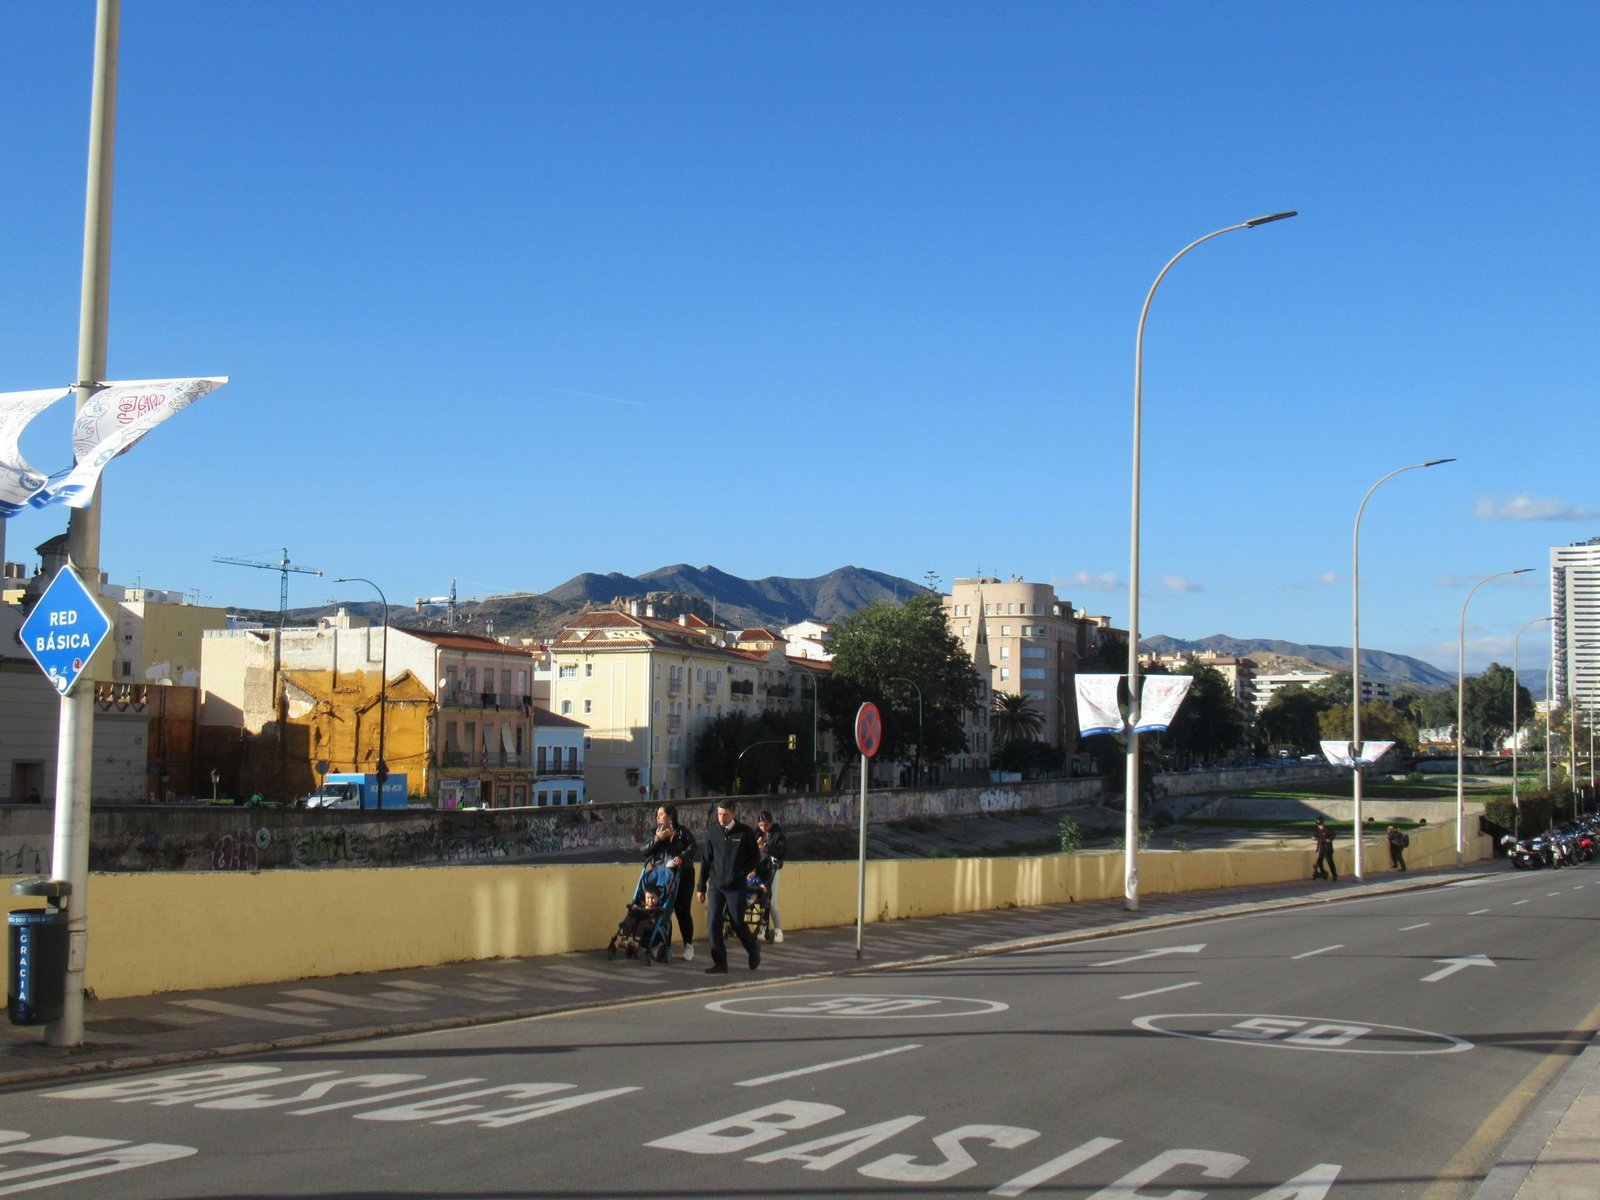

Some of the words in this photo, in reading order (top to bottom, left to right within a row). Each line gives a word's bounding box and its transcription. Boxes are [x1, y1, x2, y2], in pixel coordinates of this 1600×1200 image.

[50, 610, 78, 626] RED
[36, 631, 91, 651] BÁSICA
[19, 935, 28, 1012] GRACIAS
[767, 997, 942, 1015] 50
[1207, 1017, 1373, 1046] 50
[37, 1065, 643, 1128] BASICA
